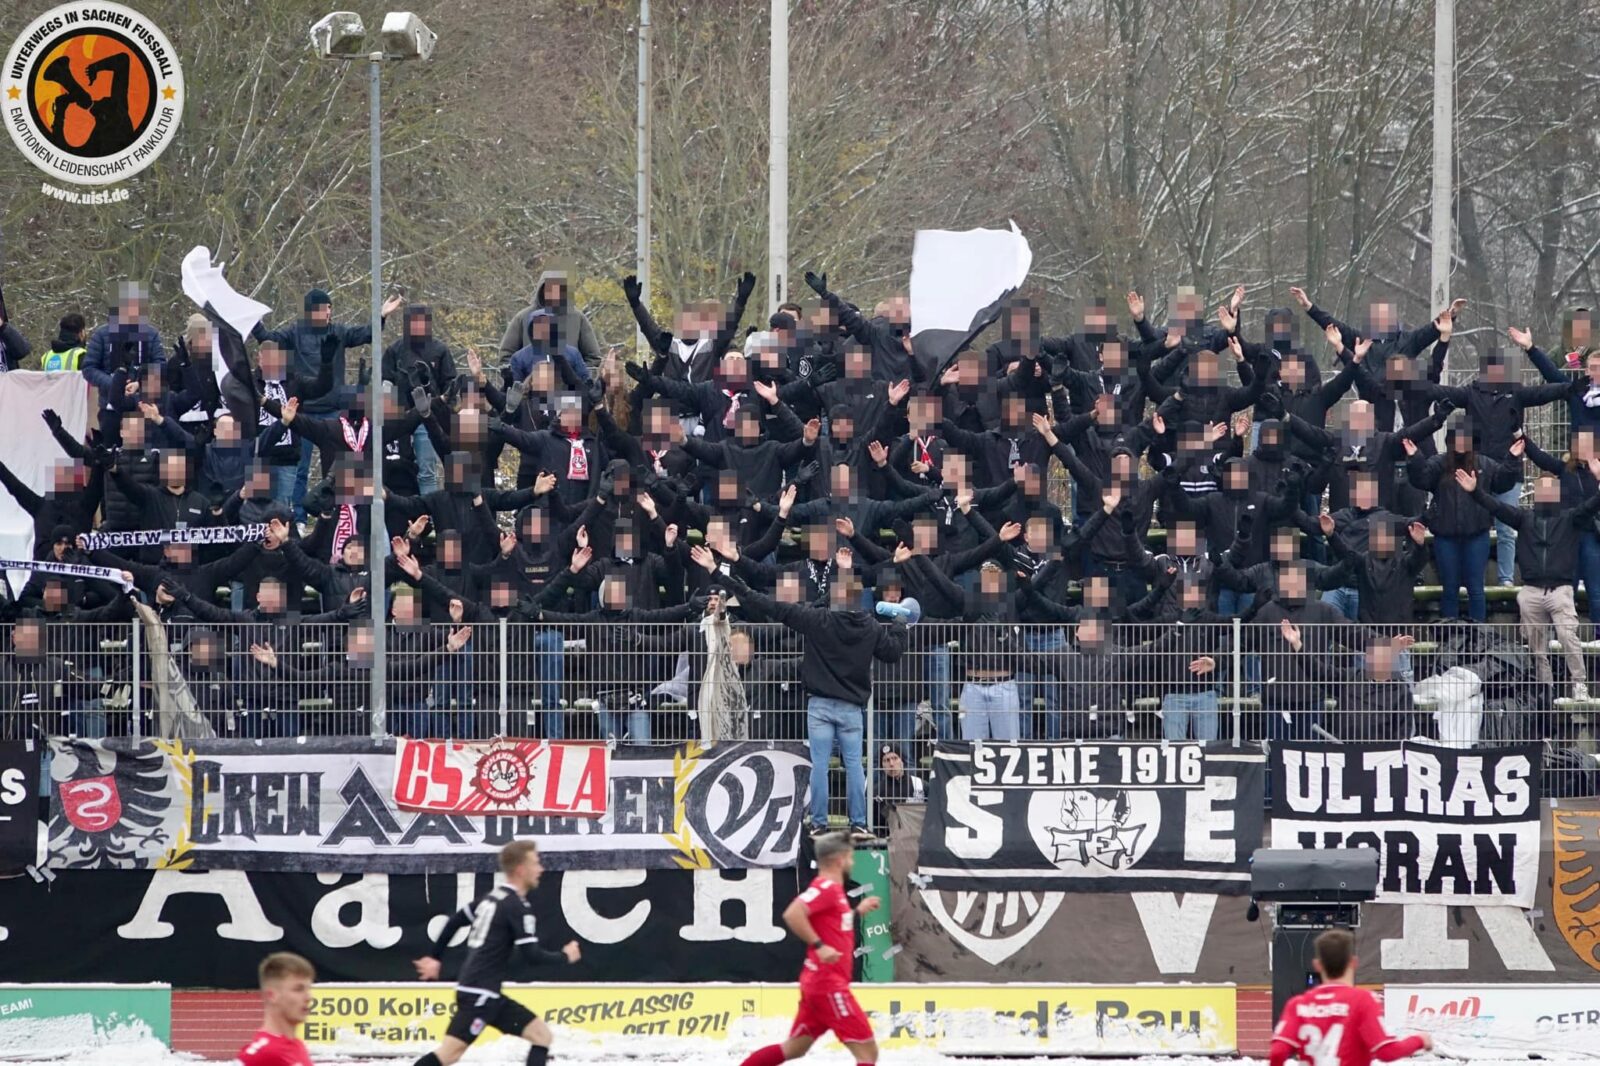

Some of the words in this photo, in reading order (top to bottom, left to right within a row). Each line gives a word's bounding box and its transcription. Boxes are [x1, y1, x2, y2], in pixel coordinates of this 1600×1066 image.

[110, 531, 161, 546] CREW
[170, 526, 236, 544] ELEVEN
[0, 560, 40, 570] SUPER
[70, 565, 111, 577] AALEN
[394, 741, 463, 808] CS
[543, 746, 607, 811] LA
[973, 746, 1100, 785] SZENE
[1117, 745, 1203, 784] 1916
[1282, 749, 1531, 816] ULTRAS
[188, 760, 325, 844] CREW
[307, 998, 369, 1016] 2500
[545, 991, 695, 1026] ERSTKLASSIG
[355, 1022, 436, 1041] Team.
[677, 1011, 730, 1036] 1971!
